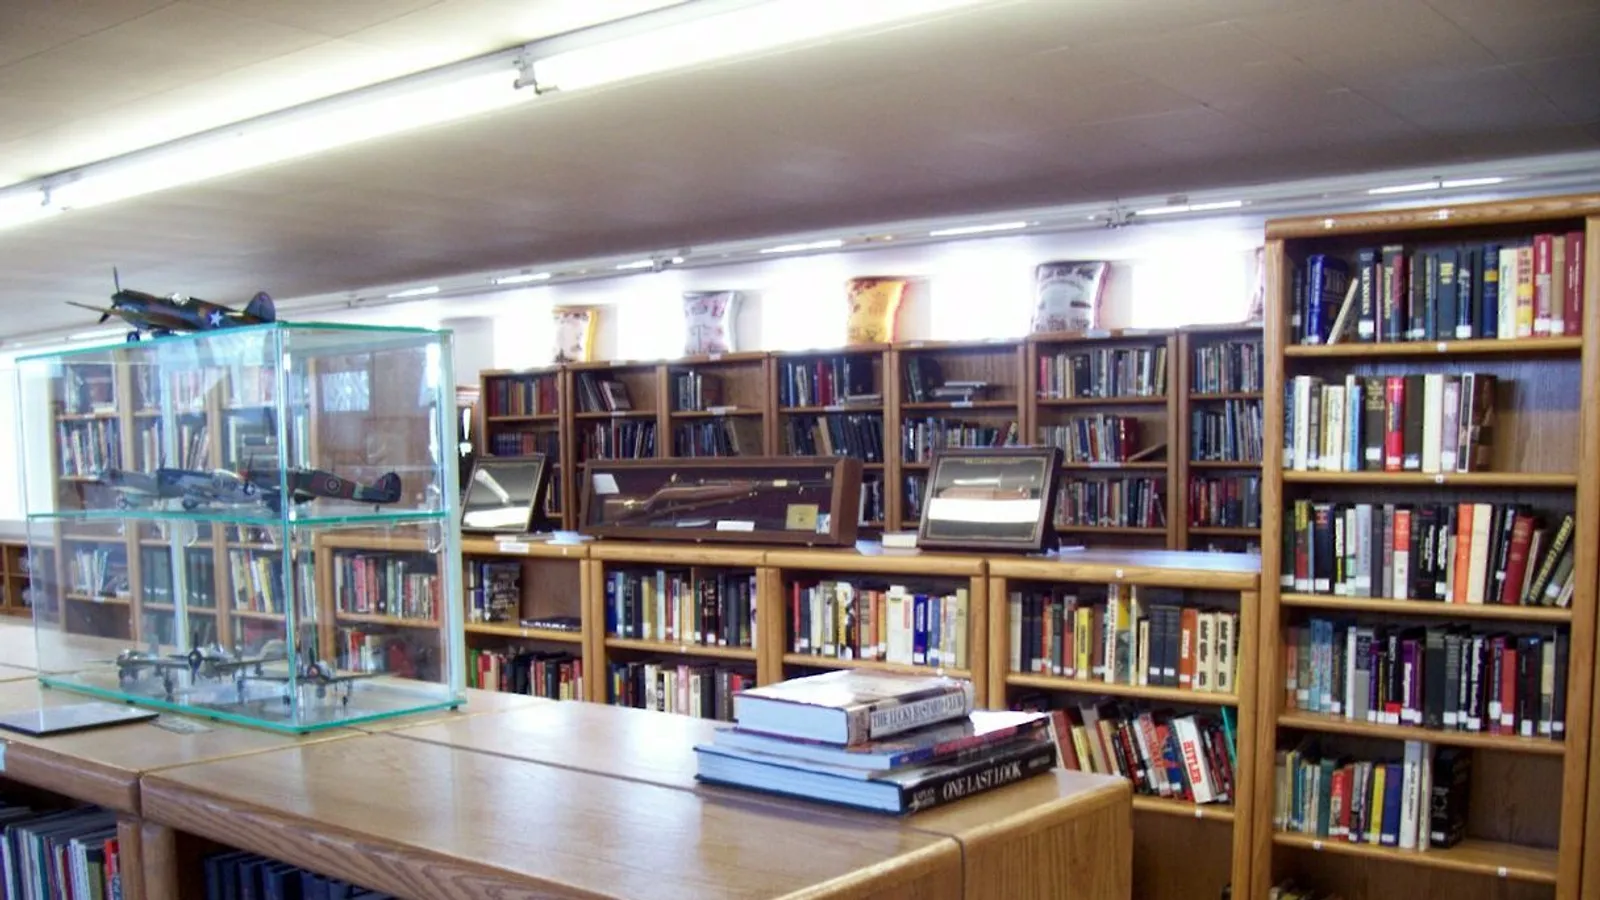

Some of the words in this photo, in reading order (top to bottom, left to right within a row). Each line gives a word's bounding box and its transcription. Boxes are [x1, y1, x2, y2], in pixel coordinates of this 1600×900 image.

[873, 711, 888, 728] THE
[890, 704, 914, 725] LUCKY
[943, 777, 966, 800] ONE
[967, 768, 994, 792] LAST
[995, 760, 1022, 784] LOOK
[1183, 741, 1202, 785] HITLER
